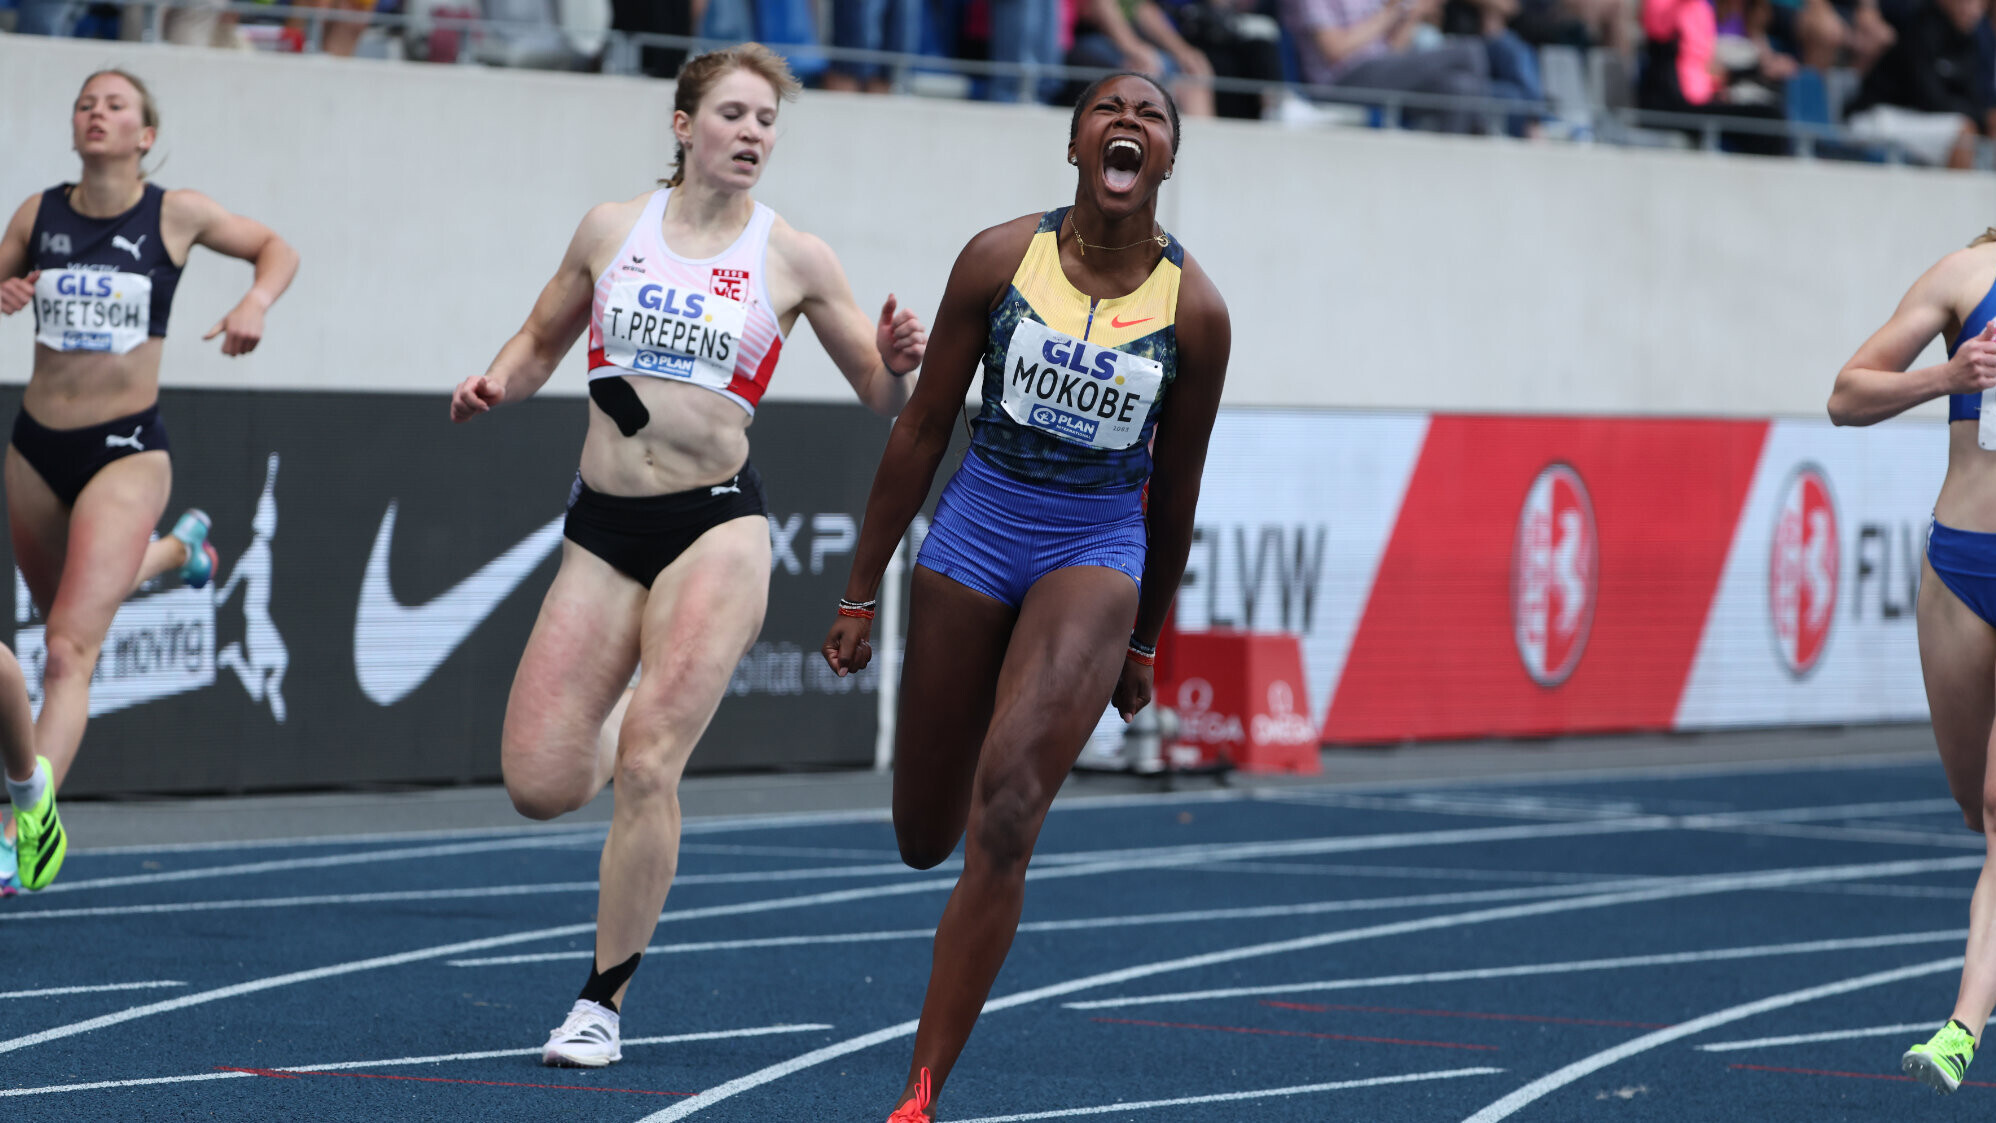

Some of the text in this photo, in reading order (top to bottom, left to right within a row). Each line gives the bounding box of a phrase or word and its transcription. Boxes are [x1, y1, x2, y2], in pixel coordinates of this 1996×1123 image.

[42, 299, 140, 328] PFETSCH
[611, 307, 732, 361] T.PREPENS
[658, 355, 692, 371] PLAN
[1012, 355, 1141, 423] MOKOBE
[1058, 414, 1095, 434] PLAN
[1852, 522, 1927, 621] FLV
